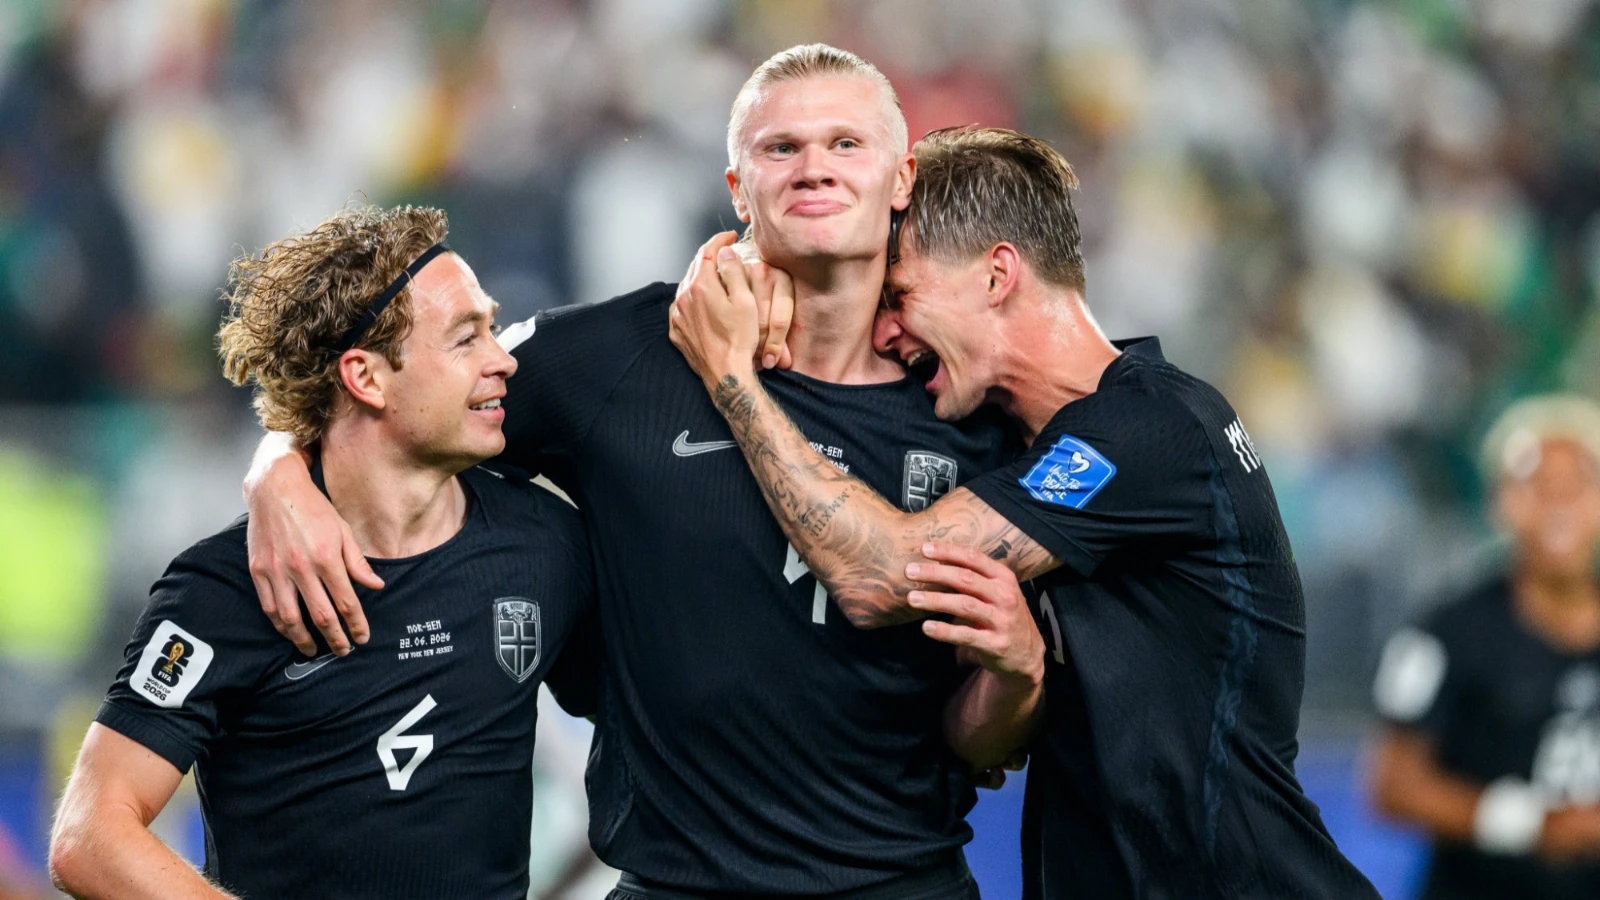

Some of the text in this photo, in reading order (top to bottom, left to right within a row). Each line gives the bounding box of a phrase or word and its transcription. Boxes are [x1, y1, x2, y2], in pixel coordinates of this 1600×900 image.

[1041, 474, 1067, 500] PEACE
[398, 646, 454, 660] NEW YORK NEW JERSEY
[146, 677, 171, 695] WORLD CUP
[157, 671, 172, 683] FIFA
[143, 682, 167, 701] 2026
[376, 693, 438, 791] 6
